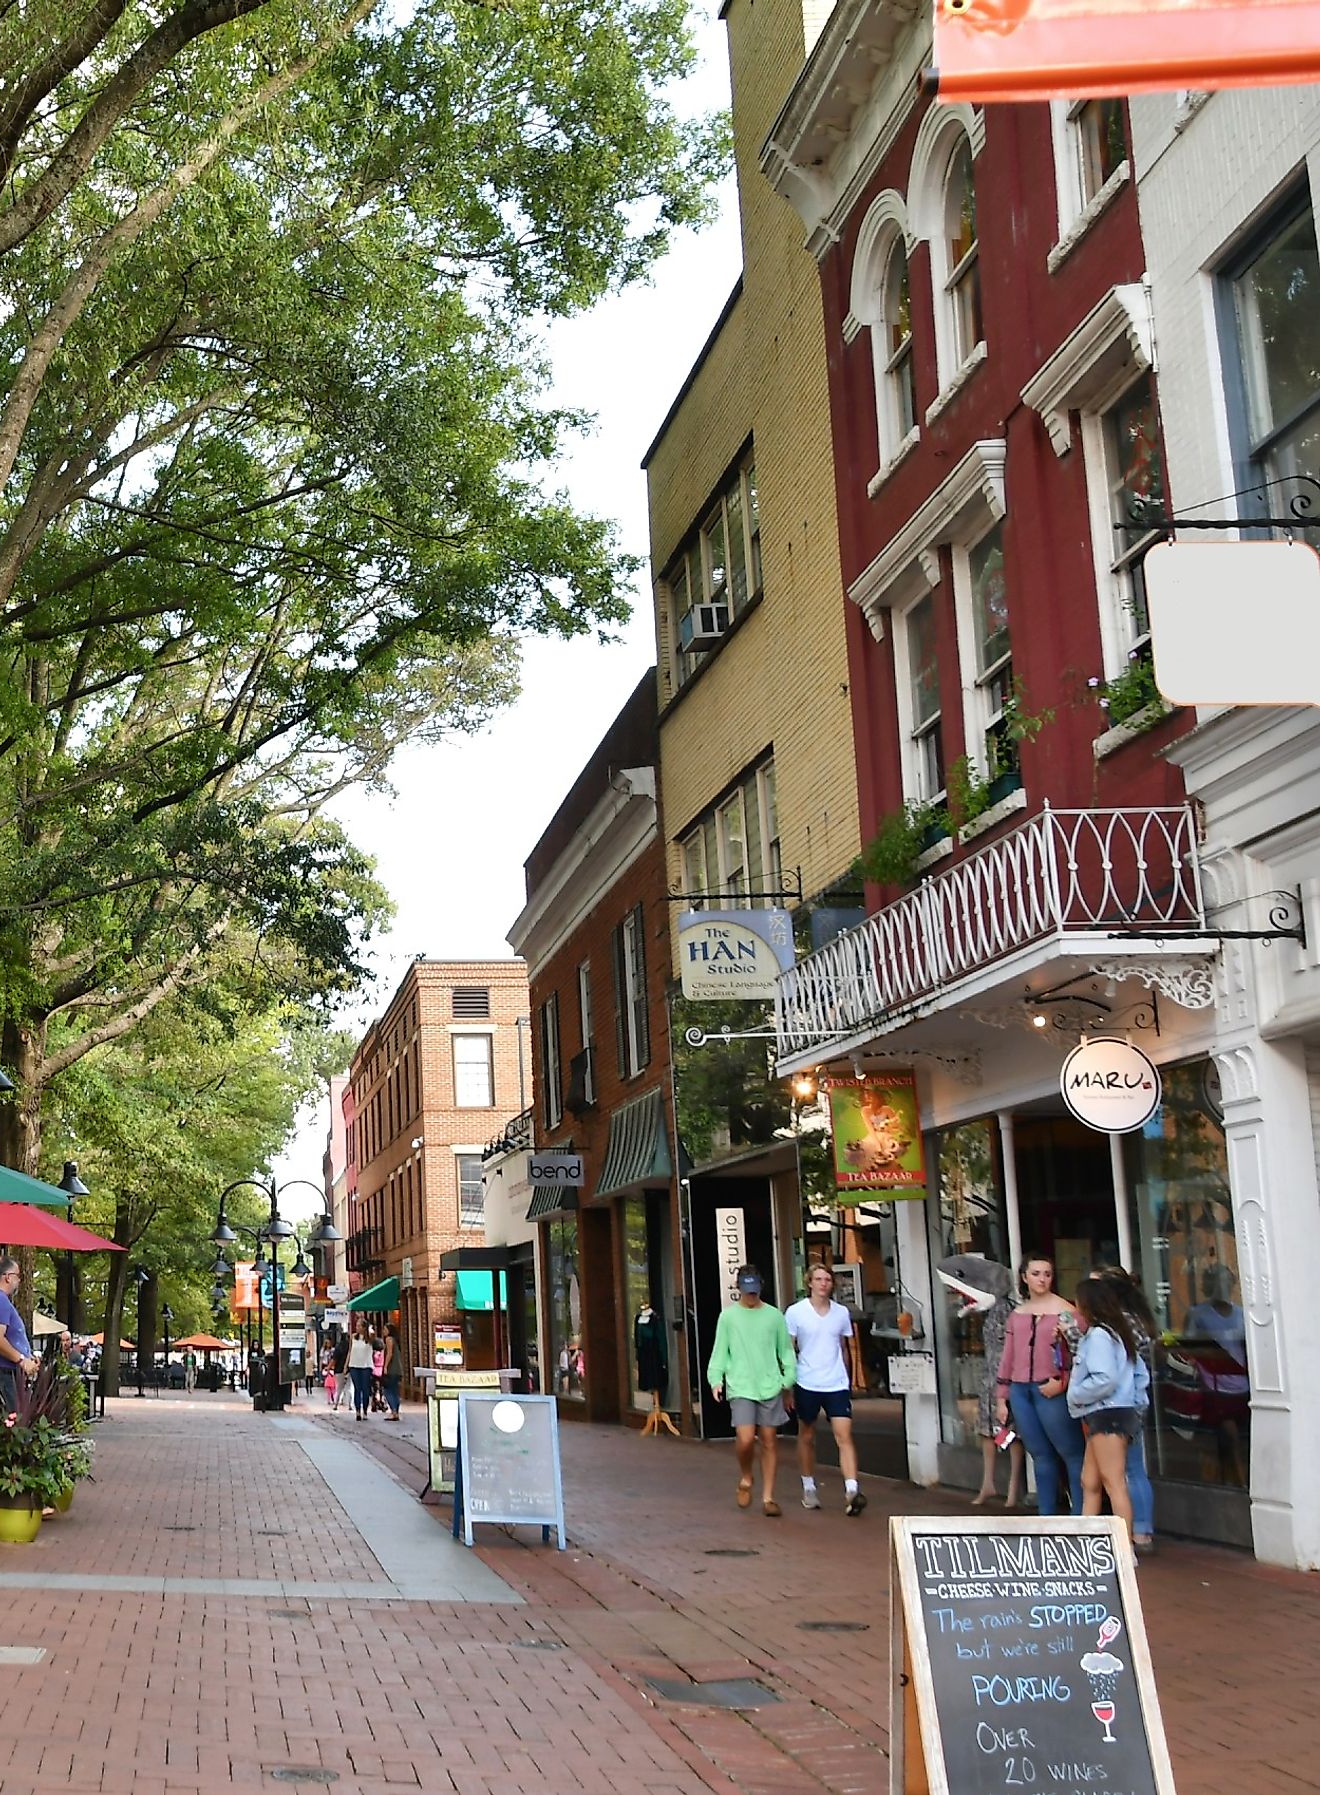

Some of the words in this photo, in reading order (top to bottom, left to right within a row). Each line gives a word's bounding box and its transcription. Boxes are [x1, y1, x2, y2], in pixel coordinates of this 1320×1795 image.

[705, 928, 730, 938] The
[688, 940, 756, 962] HAN
[707, 963, 756, 975] Studio
[703, 989, 737, 997] Culture
[730, 981, 774, 991] Language
[1070, 1072, 1143, 1090] MARU
[530, 1160, 580, 1178] bend
[848, 1172, 867, 1182] TEA
[870, 1172, 912, 1181] BAZAAR
[721, 1215, 740, 1275] studio
[439, 1374, 456, 1383] TEA
[916, 1535, 1116, 1578] TILMANS
[932, 1608, 975, 1633] The
[979, 1608, 1023, 1630] rain's
[1028, 1603, 1107, 1629] STOPPED
[956, 1638, 991, 1660] but
[1001, 1639, 1040, 1658] we're
[1047, 1636, 1075, 1655] still
[972, 1674, 1071, 1706] POURING
[1004, 1757, 1036, 1785] 20
[1047, 1762, 1109, 1781] WINES
